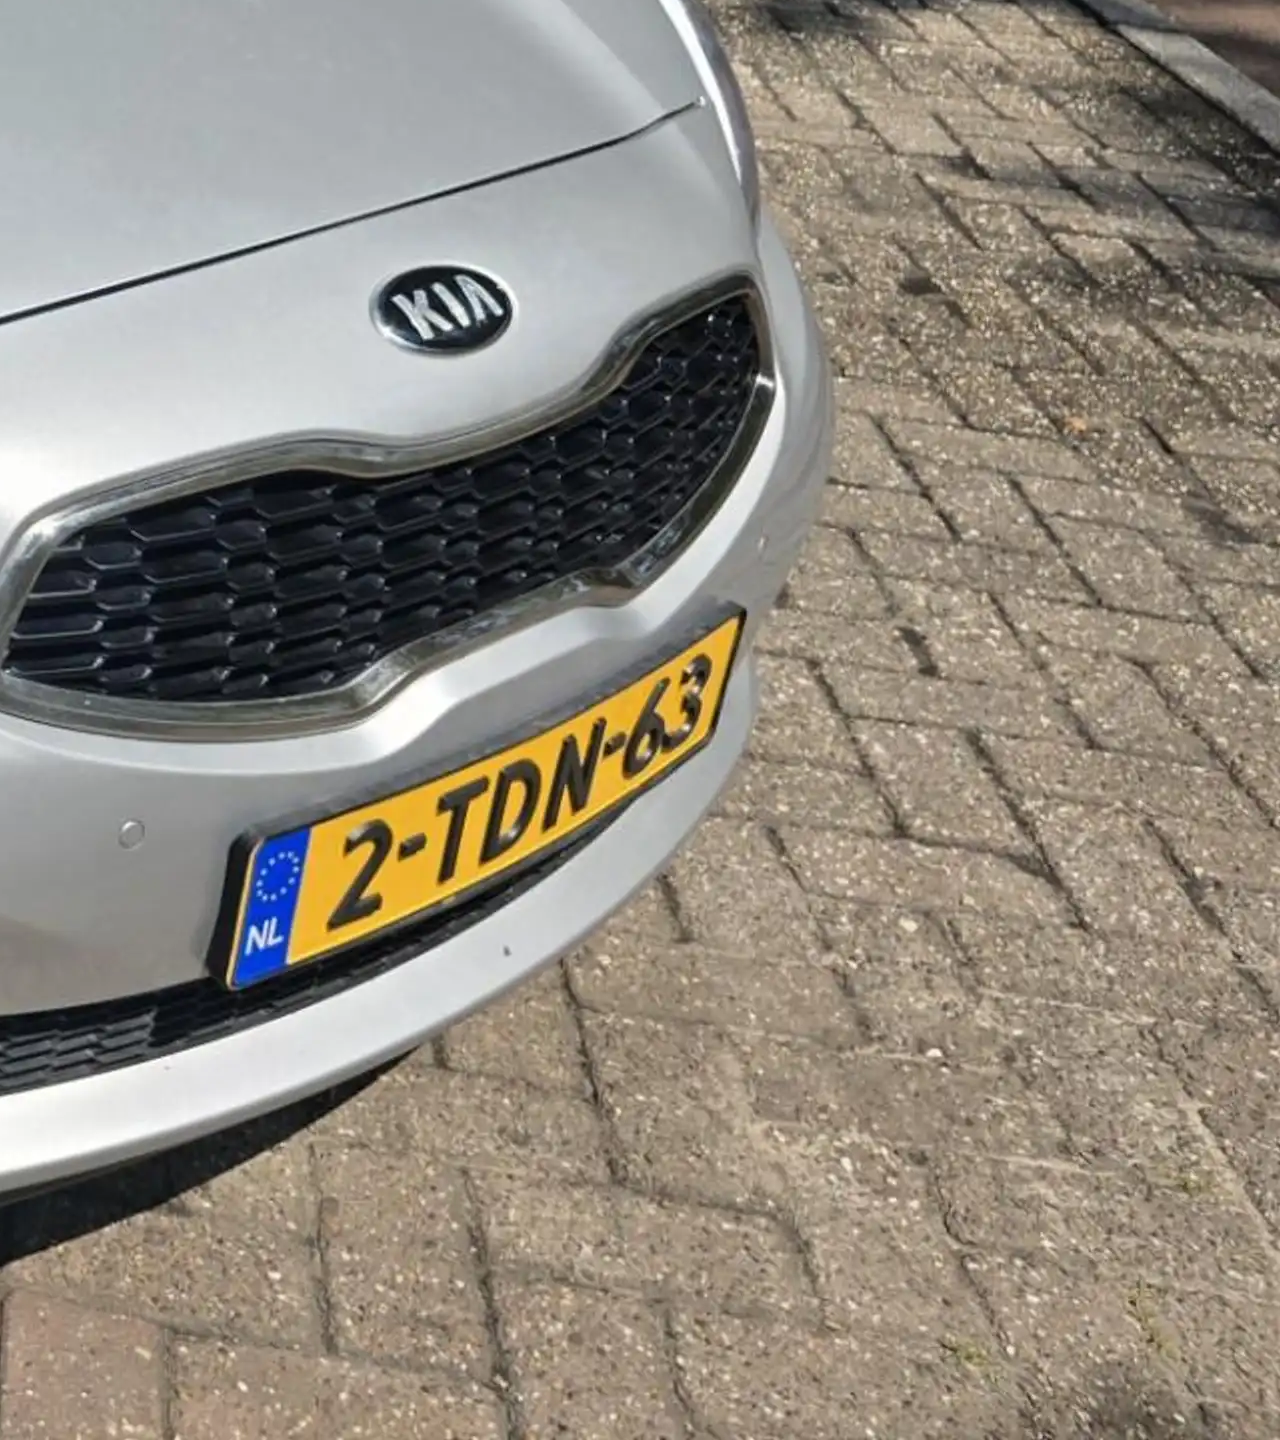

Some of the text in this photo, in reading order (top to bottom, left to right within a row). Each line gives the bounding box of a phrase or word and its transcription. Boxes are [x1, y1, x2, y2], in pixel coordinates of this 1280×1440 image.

[391, 274, 504, 341] KIA
[326, 653, 712, 932] 2-TDN-63
[244, 916, 284, 957] NL
